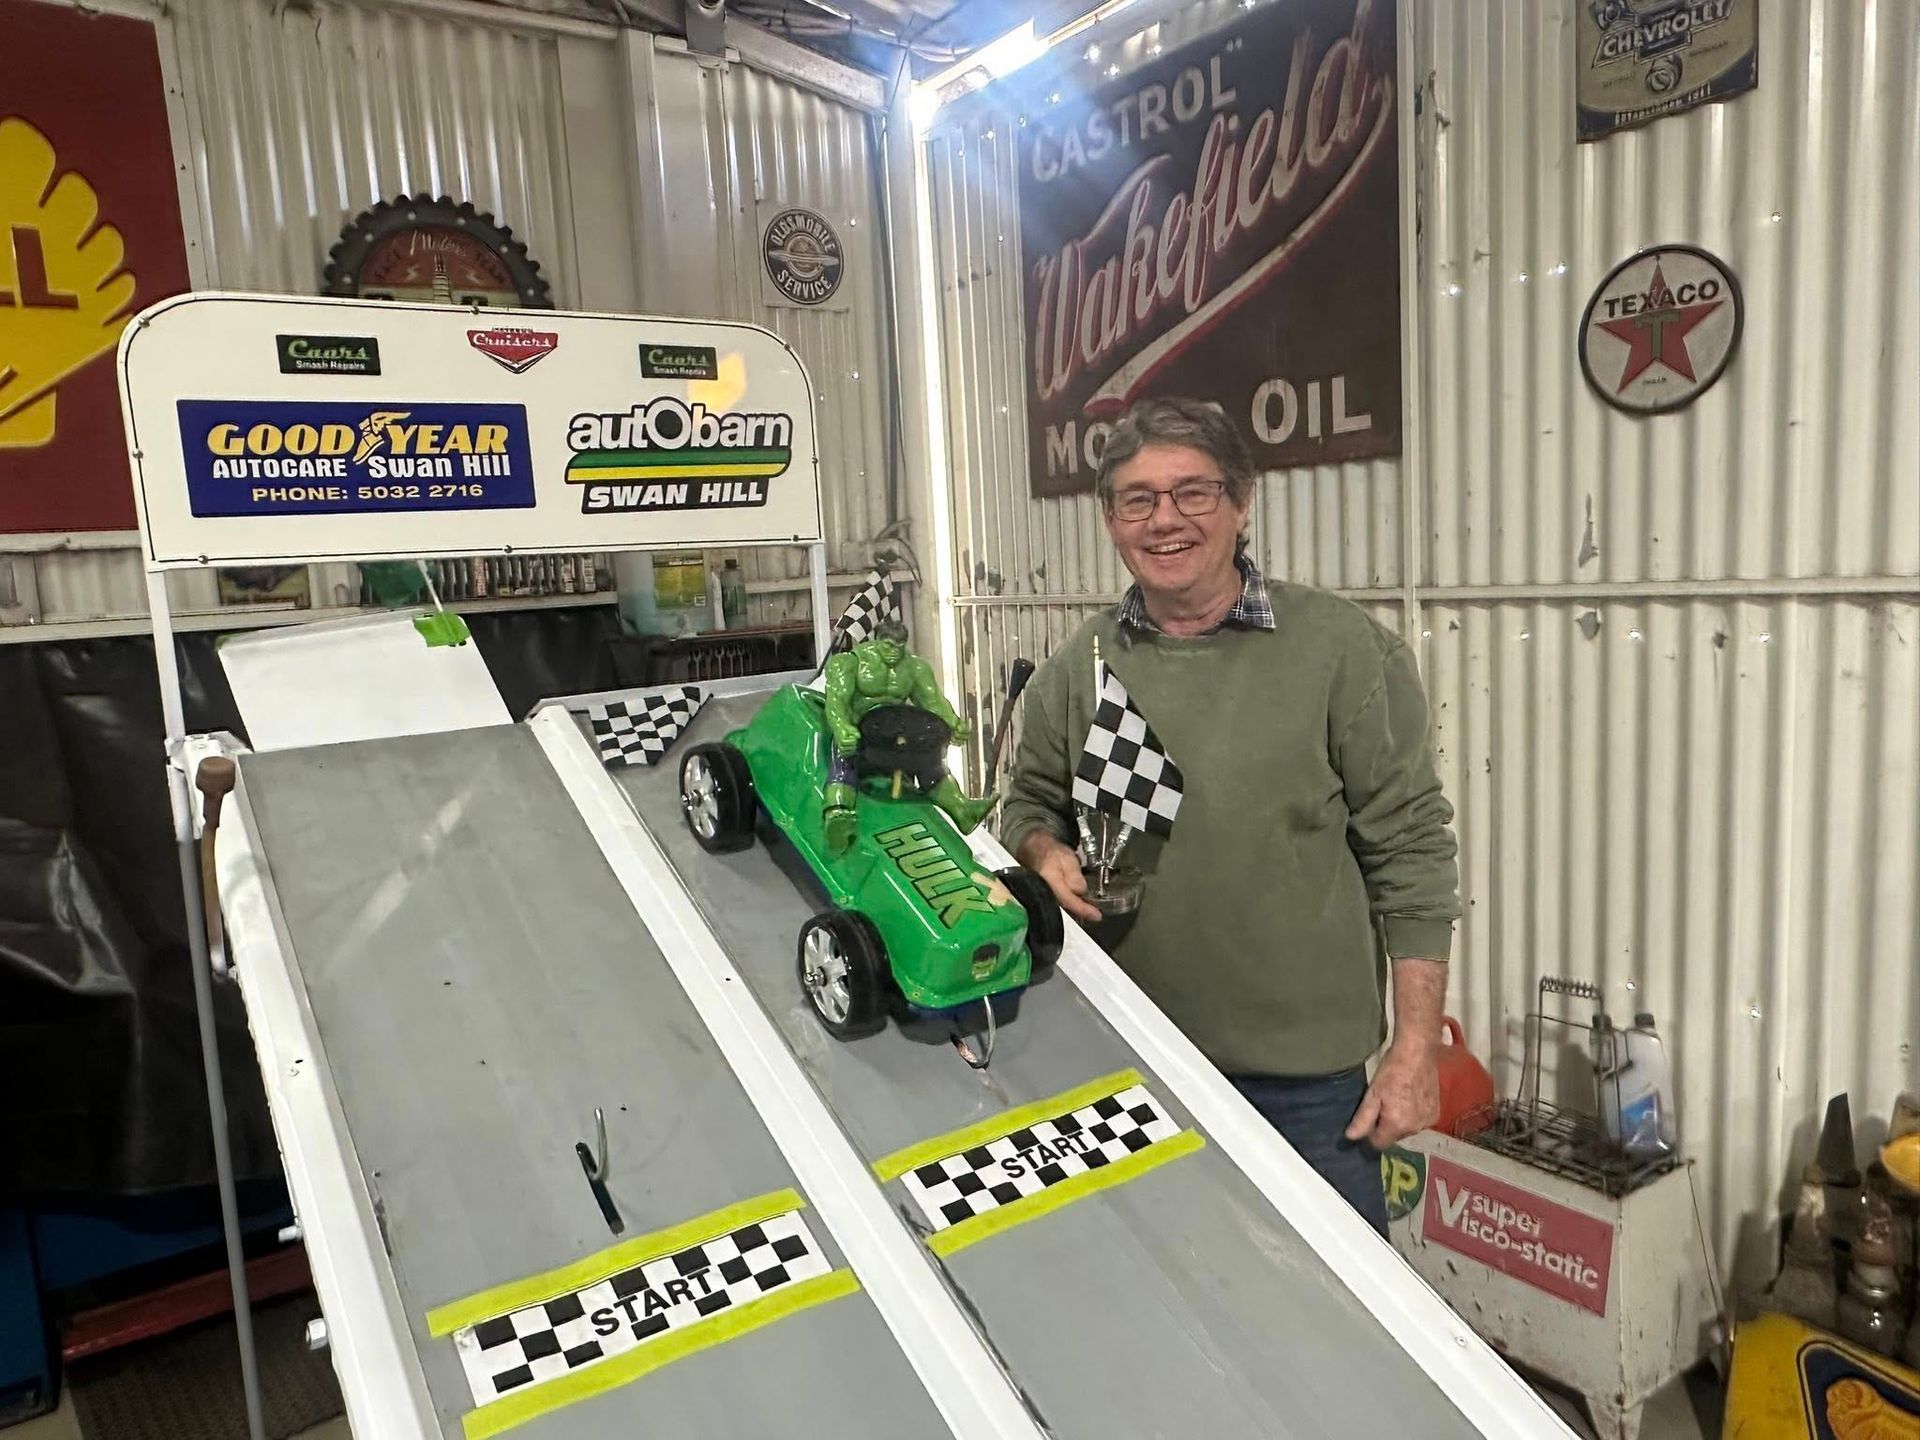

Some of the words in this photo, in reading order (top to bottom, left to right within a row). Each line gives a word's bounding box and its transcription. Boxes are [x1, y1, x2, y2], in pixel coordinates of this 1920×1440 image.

[1602, 1, 1727, 57] CHEVROLET
[1033, 0, 1376, 401] Wakefield
[770, 214, 836, 252] OLDSMOBILE
[776, 269, 832, 299] SERVICE
[1604, 279, 1720, 318] TEXACO
[473, 332, 552, 348] Cruisers
[295, 360, 328, 369] Smash
[330, 361, 366, 371] Repairs
[1251, 375, 1372, 445] OIL
[212, 457, 348, 479] AUTOCARE
[368, 455, 453, 479] Swan
[462, 453, 511, 477] Hill
[252, 486, 348, 502] PHONE:
[358, 485, 421, 500] 5032
[428, 484, 484, 498] 2716
[588, 483, 689, 509] SWAN
[700, 481, 764, 504] HILL
[873, 819, 997, 930] HULK
[1000, 1130, 1089, 1179] START
[1434, 1176, 1599, 1290] Visco-static
[590, 1267, 712, 1337] START
